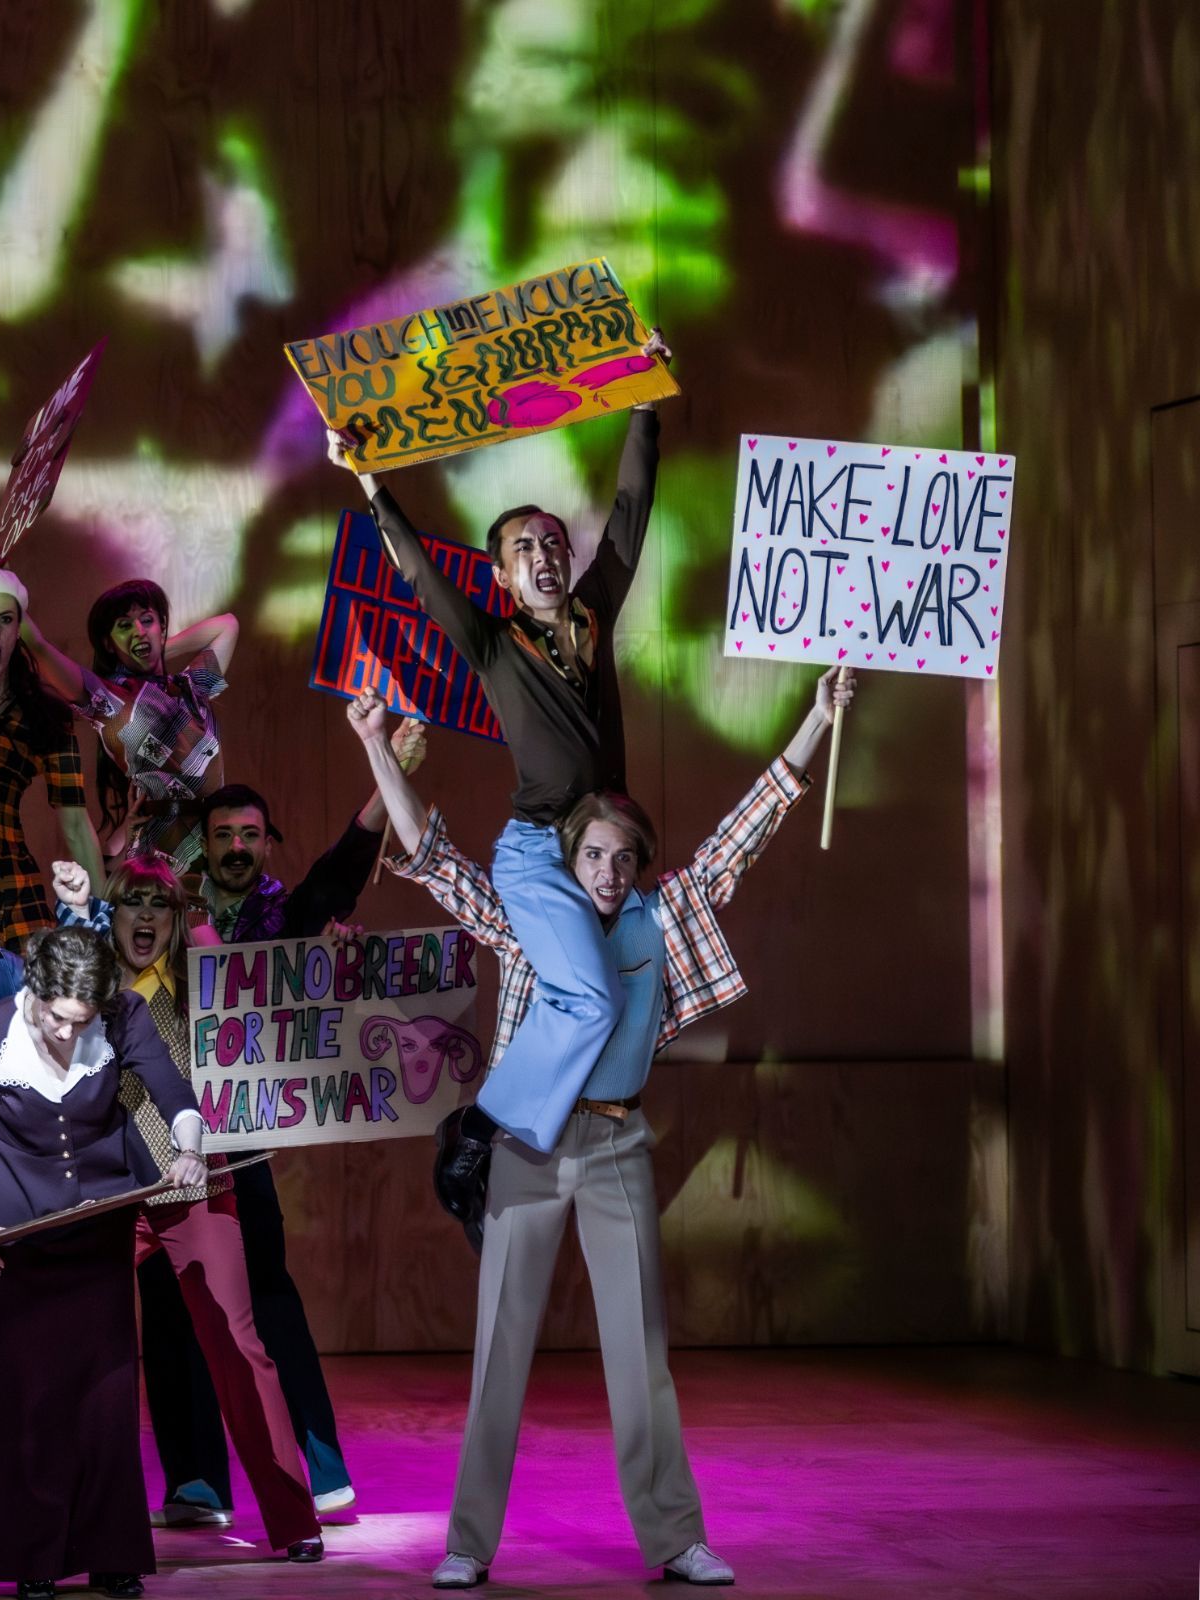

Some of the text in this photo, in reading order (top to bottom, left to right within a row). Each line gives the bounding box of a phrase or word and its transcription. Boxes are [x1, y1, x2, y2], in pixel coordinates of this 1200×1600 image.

[290, 308, 453, 379] ENOUGH
[471, 264, 625, 333] ENOUGH
[308, 365, 396, 419] YOU
[741, 458, 1012, 553] MAKE LOVE
[199, 930, 476, 1009] I'M NO BREEDER
[195, 1007, 343, 1068] FOR THE
[201, 1067, 399, 1134] MAN'S WAR
